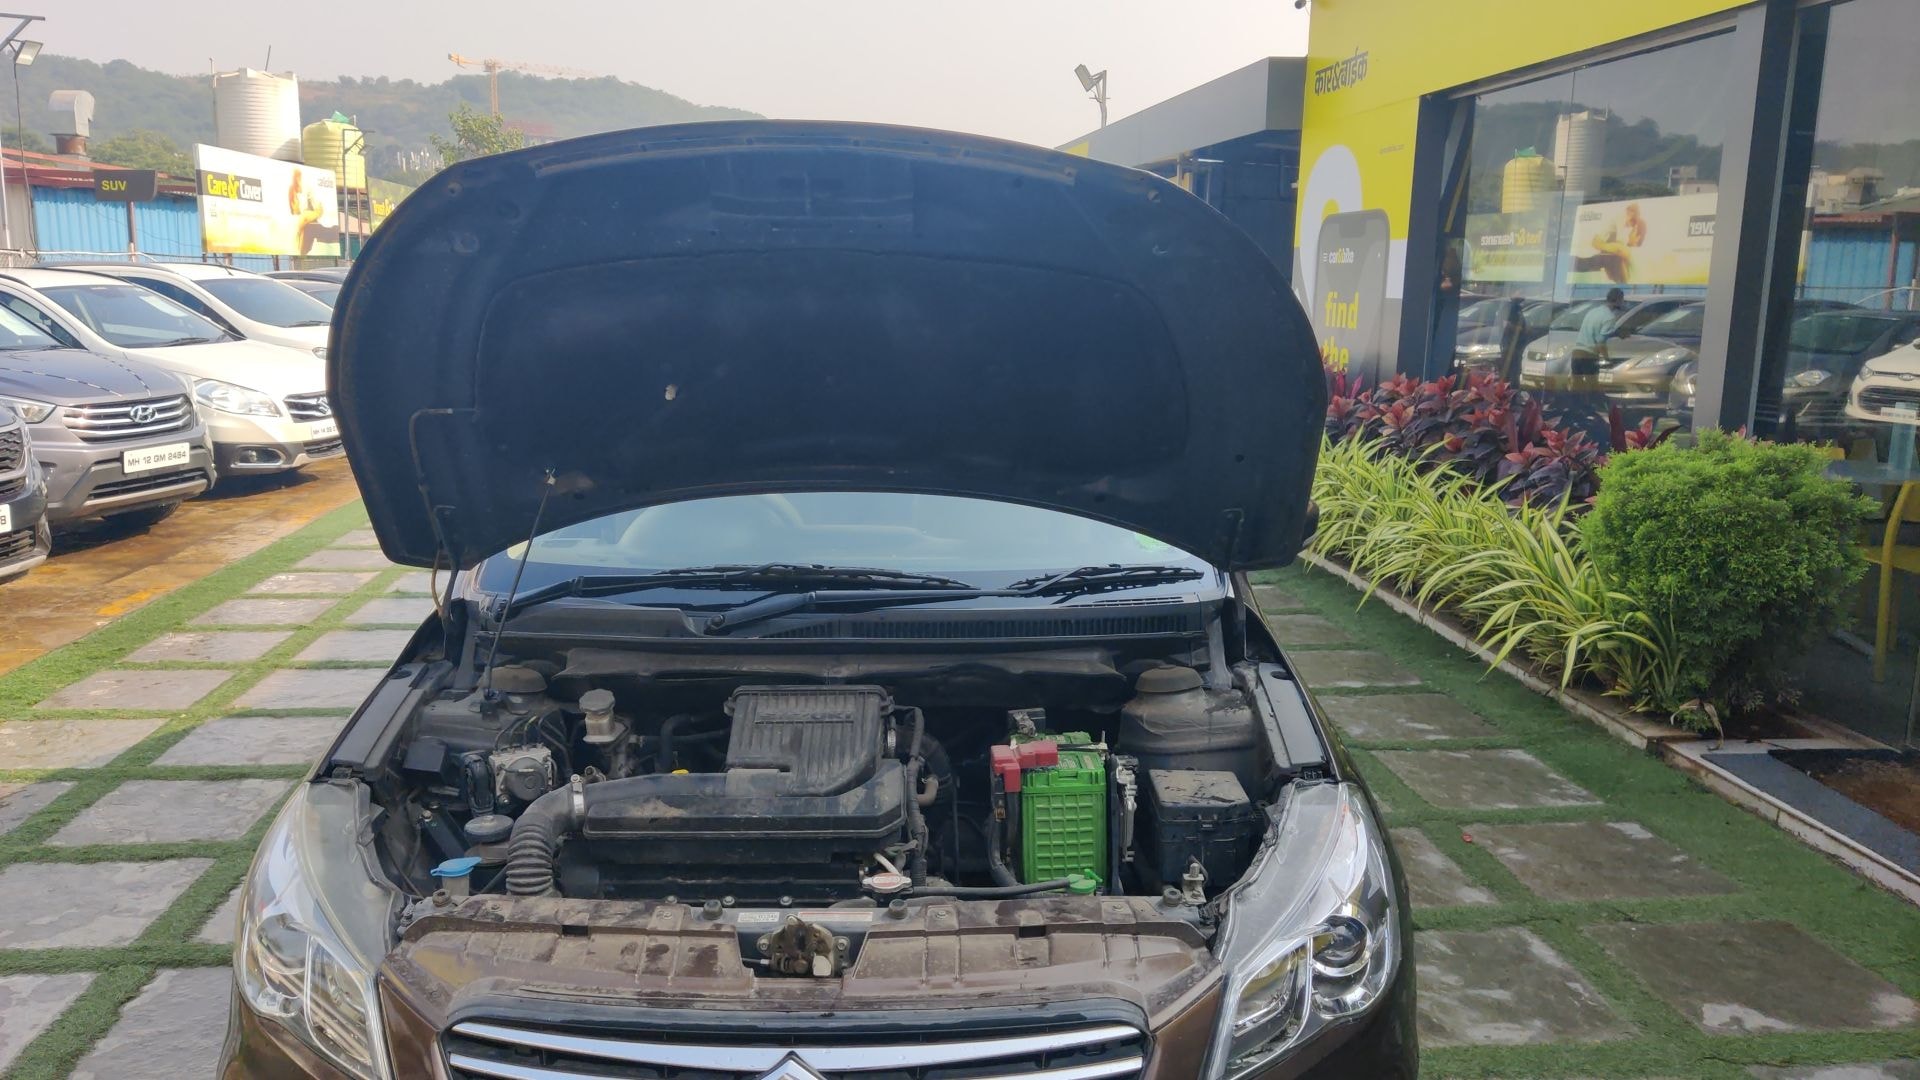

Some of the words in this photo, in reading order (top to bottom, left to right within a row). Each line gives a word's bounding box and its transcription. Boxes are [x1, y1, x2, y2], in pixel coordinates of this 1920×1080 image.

[101, 180, 127, 191] SUV
[1325, 291, 1359, 329] find
[1322, 335, 1349, 366] the
[127, 458, 140, 467] MH
[143, 455, 151, 464] 12
